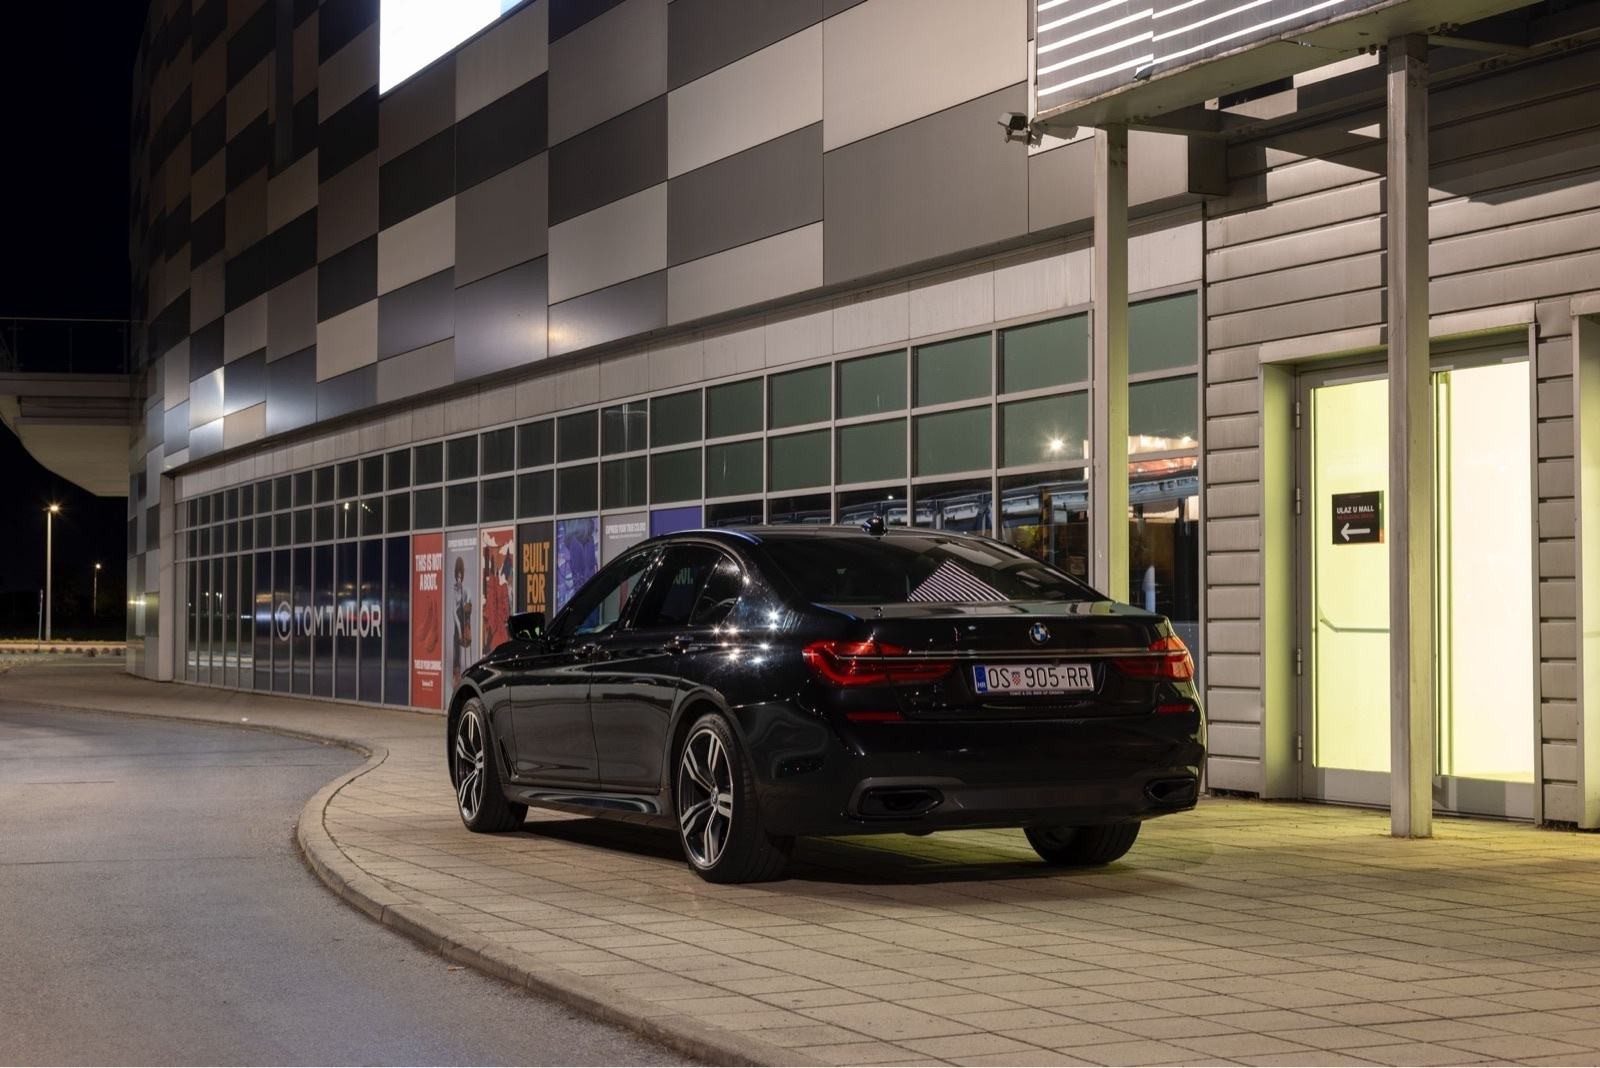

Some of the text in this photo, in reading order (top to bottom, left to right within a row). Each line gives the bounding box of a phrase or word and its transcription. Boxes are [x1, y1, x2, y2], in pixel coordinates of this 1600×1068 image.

[415, 552, 442, 572] THIS IS NOT
[523, 543, 549, 573] BUILT
[419, 573, 424, 592] A
[527, 573, 546, 603] FOR
[294, 605, 381, 637] TOM TAILOR
[988, 667, 1011, 689] OS
